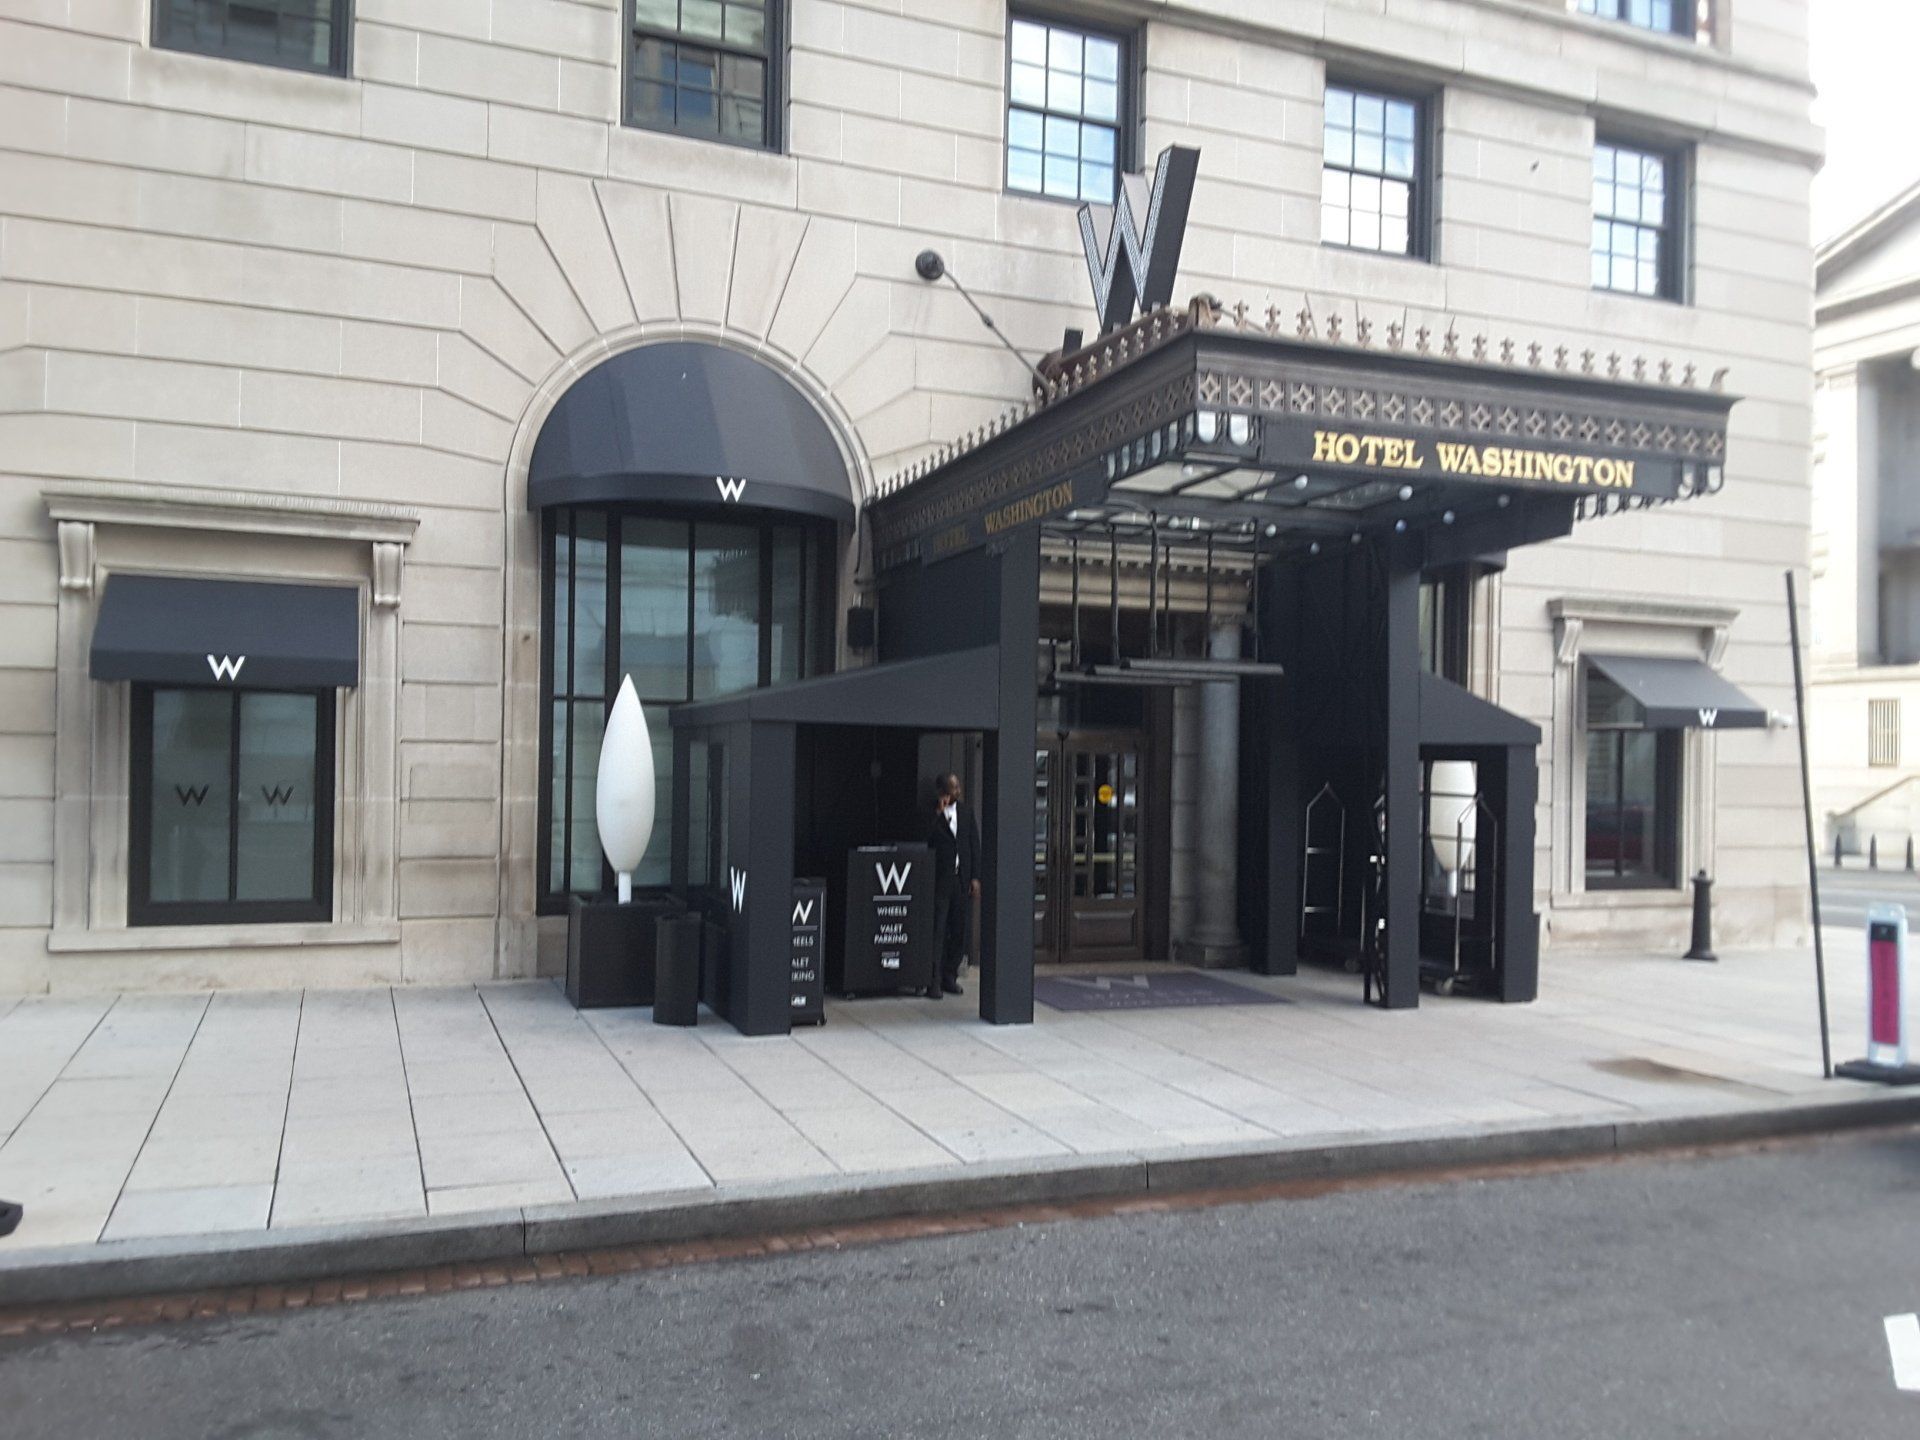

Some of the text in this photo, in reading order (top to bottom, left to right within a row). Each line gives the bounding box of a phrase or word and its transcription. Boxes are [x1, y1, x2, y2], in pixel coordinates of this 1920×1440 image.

[1077, 142, 1201, 334] W
[1312, 431, 1635, 488] HOTEL WASHINGTON
[716, 476, 747, 502] W
[984, 479, 1073, 535] WASHINGTON
[207, 654, 246, 681] W
[1698, 707, 1718, 727] W
[175, 783, 210, 807] W
[261, 784, 295, 807] W
[730, 865, 747, 915] W
[875, 862, 912, 895] W
[877, 906, 908, 917] WHEELS
[873, 933, 908, 945] PARKING
[880, 923, 903, 934] VALET
[791, 957, 809, 969] ALET
[791, 970, 815, 982] KING
